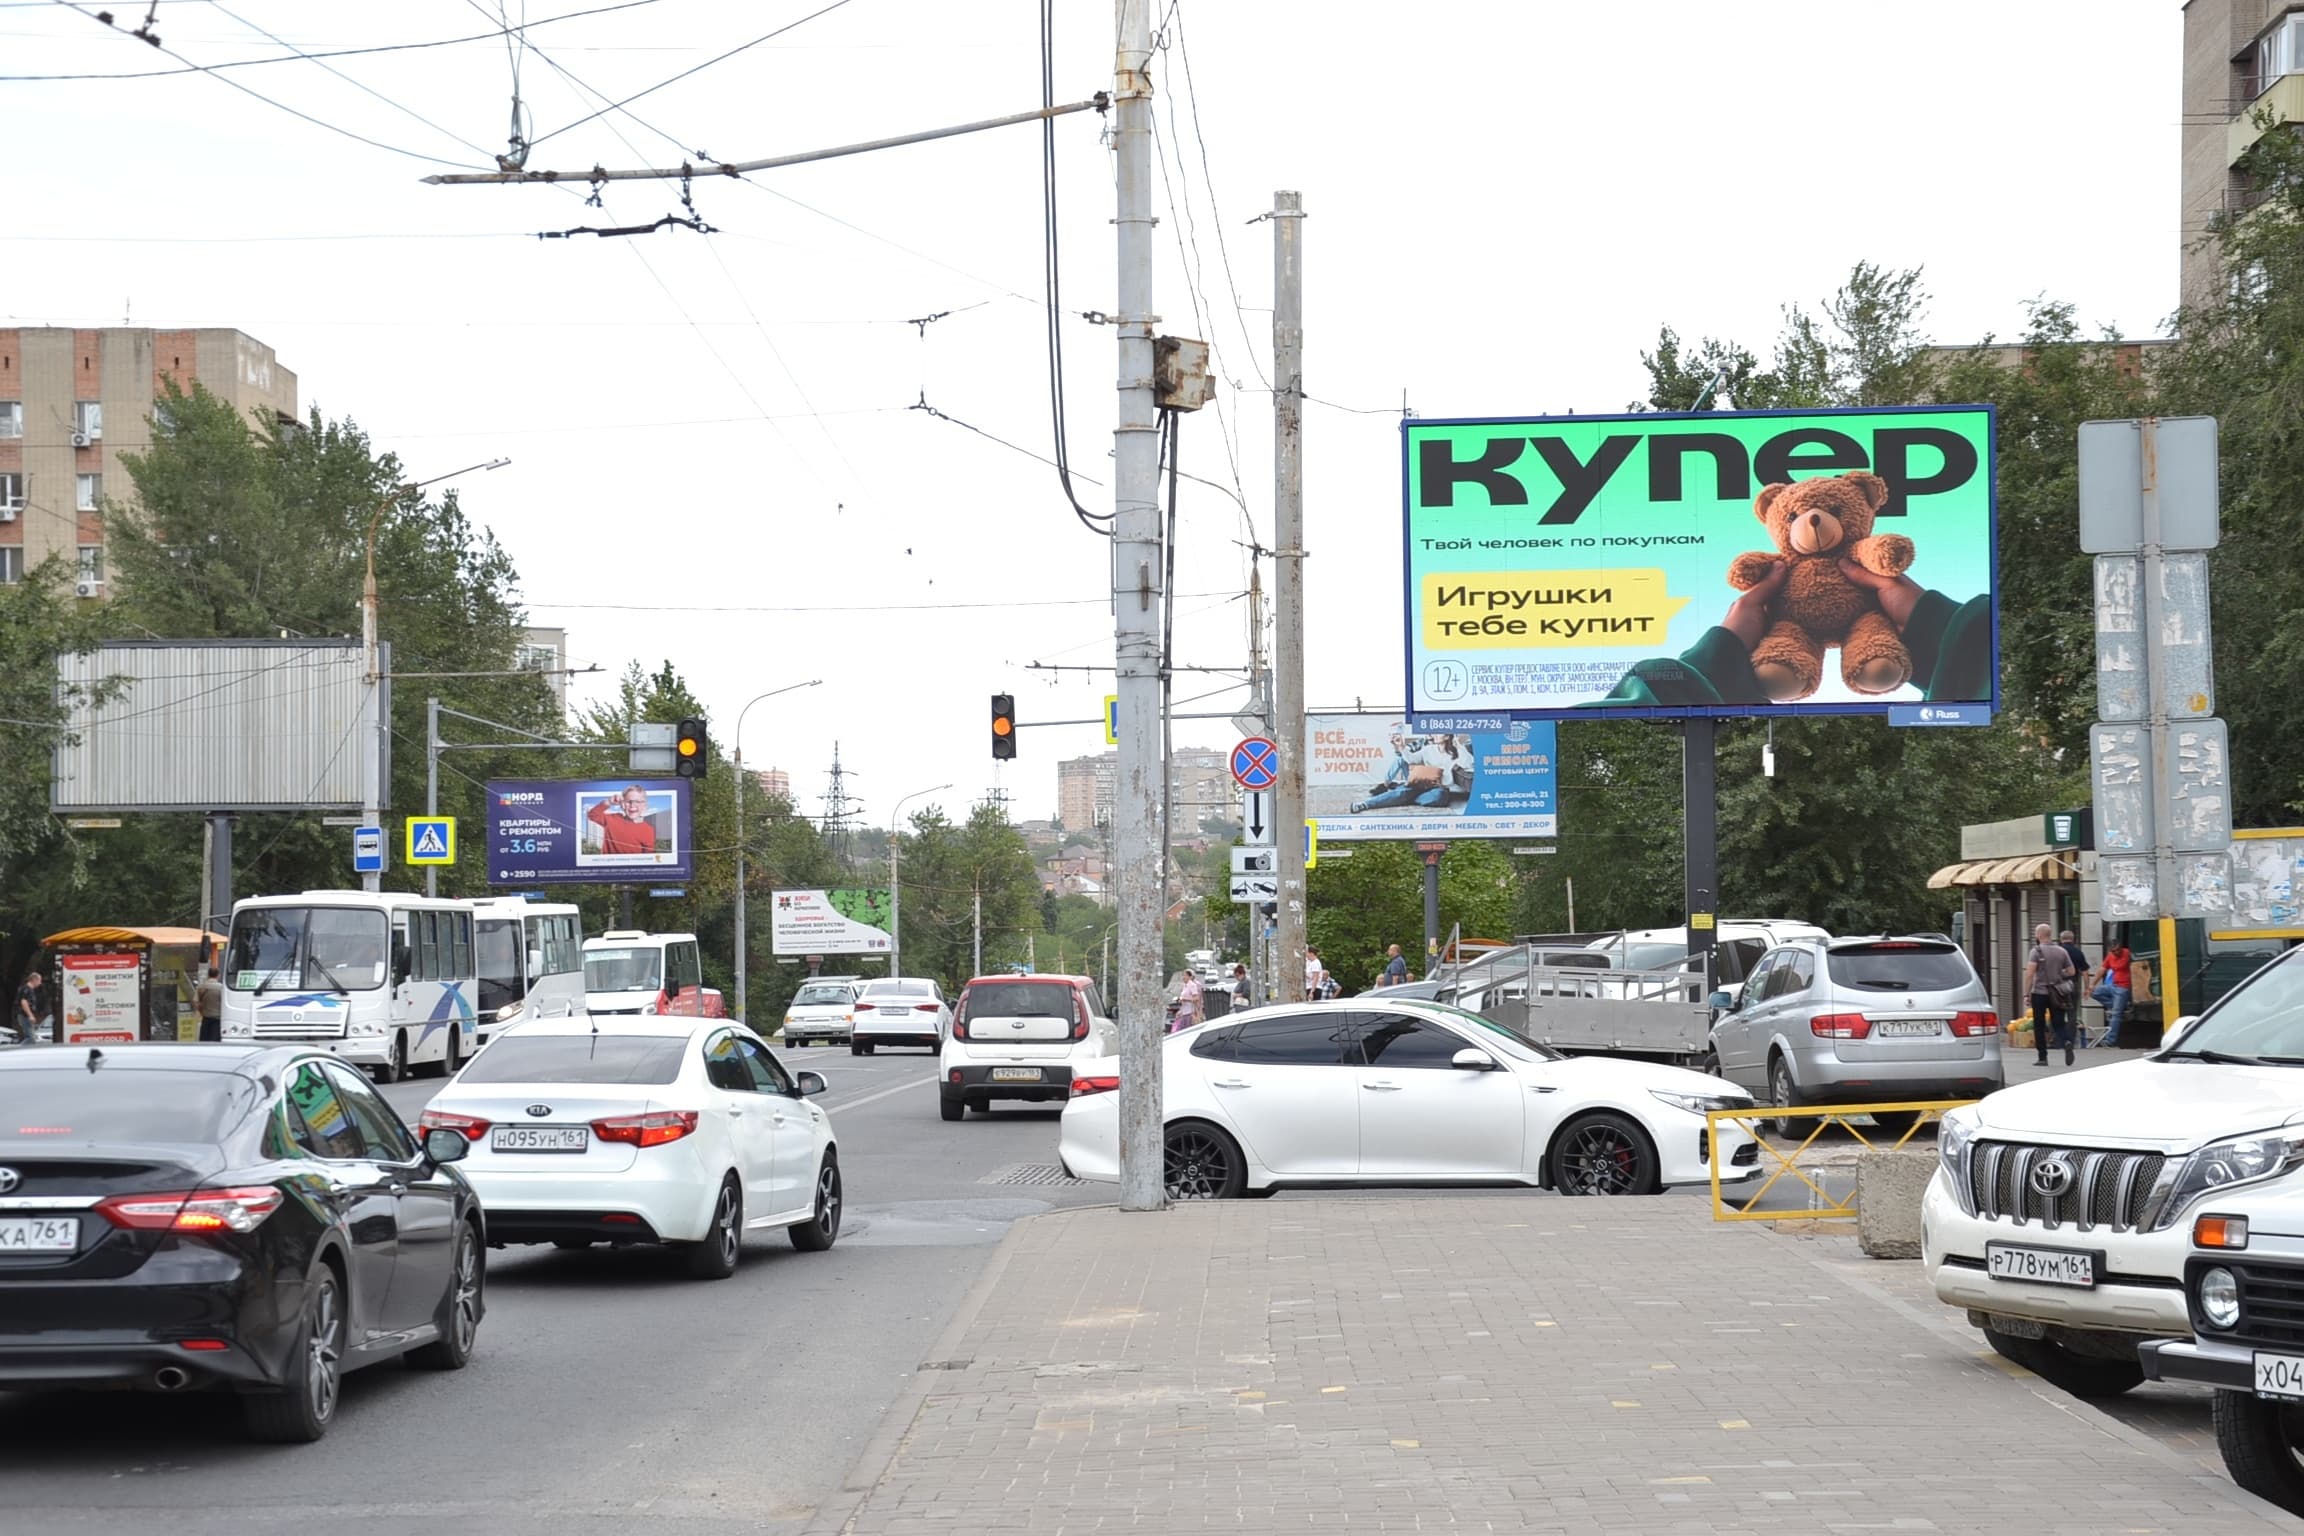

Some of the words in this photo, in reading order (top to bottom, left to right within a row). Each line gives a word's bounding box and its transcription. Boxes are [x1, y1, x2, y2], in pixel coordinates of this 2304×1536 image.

[1421, 537, 1473, 551] Твой
[1479, 538, 1564, 549] человек
[1571, 536, 1596, 548] по
[1602, 535, 1705, 548] покупкам
[1438, 585, 1612, 611] Игрушки
[1437, 614, 1528, 637] тебе
[1540, 616, 1654, 639] купит
[1433, 665, 1461, 693] 12+
[1935, 710, 1960, 719] Russ
[1420, 720, 1427, 729] 8
[1430, 719, 1454, 730] (863)
[1456, 719, 1502, 729] 226-77-26
[1314, 728, 1345, 745] ВСЁ
[1314, 747, 1384, 759] РЕМОНТА
[1501, 743, 1531, 754] МИР
[1483, 755, 1549, 766] РЕМОНТА
[1324, 762, 1369, 773] УЮТА!
[1484, 768, 1524, 776] ТОРГОВЫЙ
[1525, 767, 1549, 776] ЦЕНТР
[511, 792, 544, 801] НОРД
[499, 819, 551, 828] КВАРТИРЫ
[1359, 823, 1414, 831] САНТЕХНИКА
[1421, 823, 1448, 831] ДВЕРИ
[1455, 822, 1488, 830] МЕБЕЛЬ
[1495, 821, 1516, 829] СВЕТ
[1522, 821, 1551, 829] ДЕКОР
[508, 827, 562, 836] РЕМОНТОМ
[510, 838, 536, 853] 3.6
[94, 973, 134, 981] ВИЗИТКИ
[529, 1106, 548, 1115] KIA
[33, 1221, 70, 1240] 761
